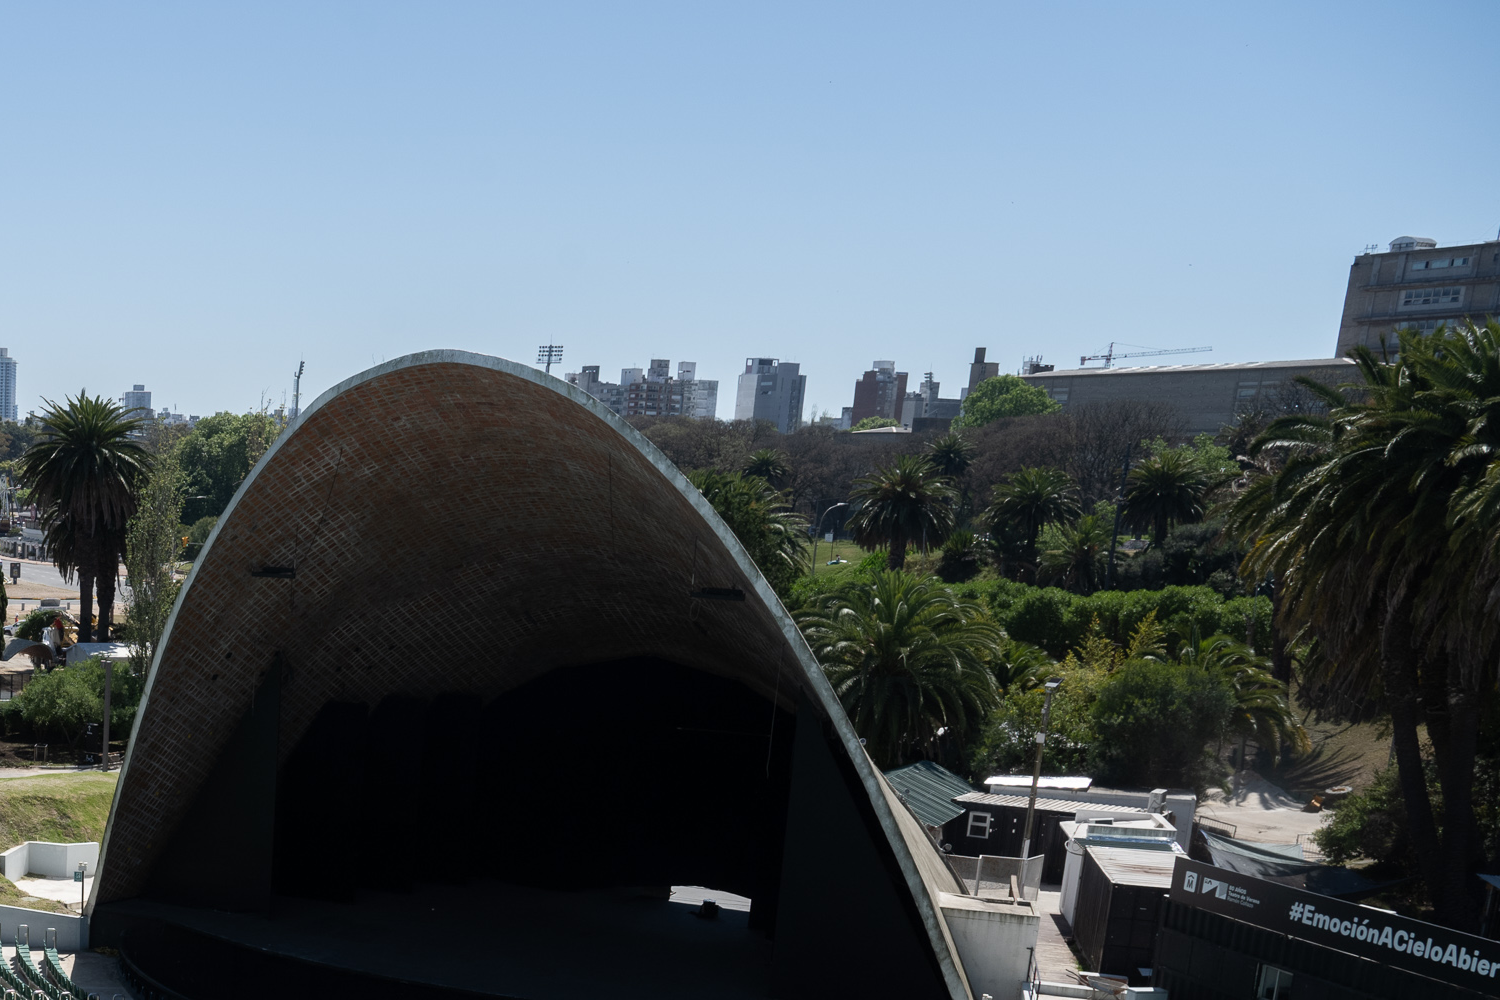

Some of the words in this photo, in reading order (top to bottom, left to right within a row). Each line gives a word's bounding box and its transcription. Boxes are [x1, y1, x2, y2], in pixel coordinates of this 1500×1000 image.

[1229, 890, 1240, 898] Teatro
[1247, 896, 1260, 904] Verano
[1235, 886, 1247, 895] AÑOS
[1289, 901, 1500, 978] #EmociónACieloAbier
